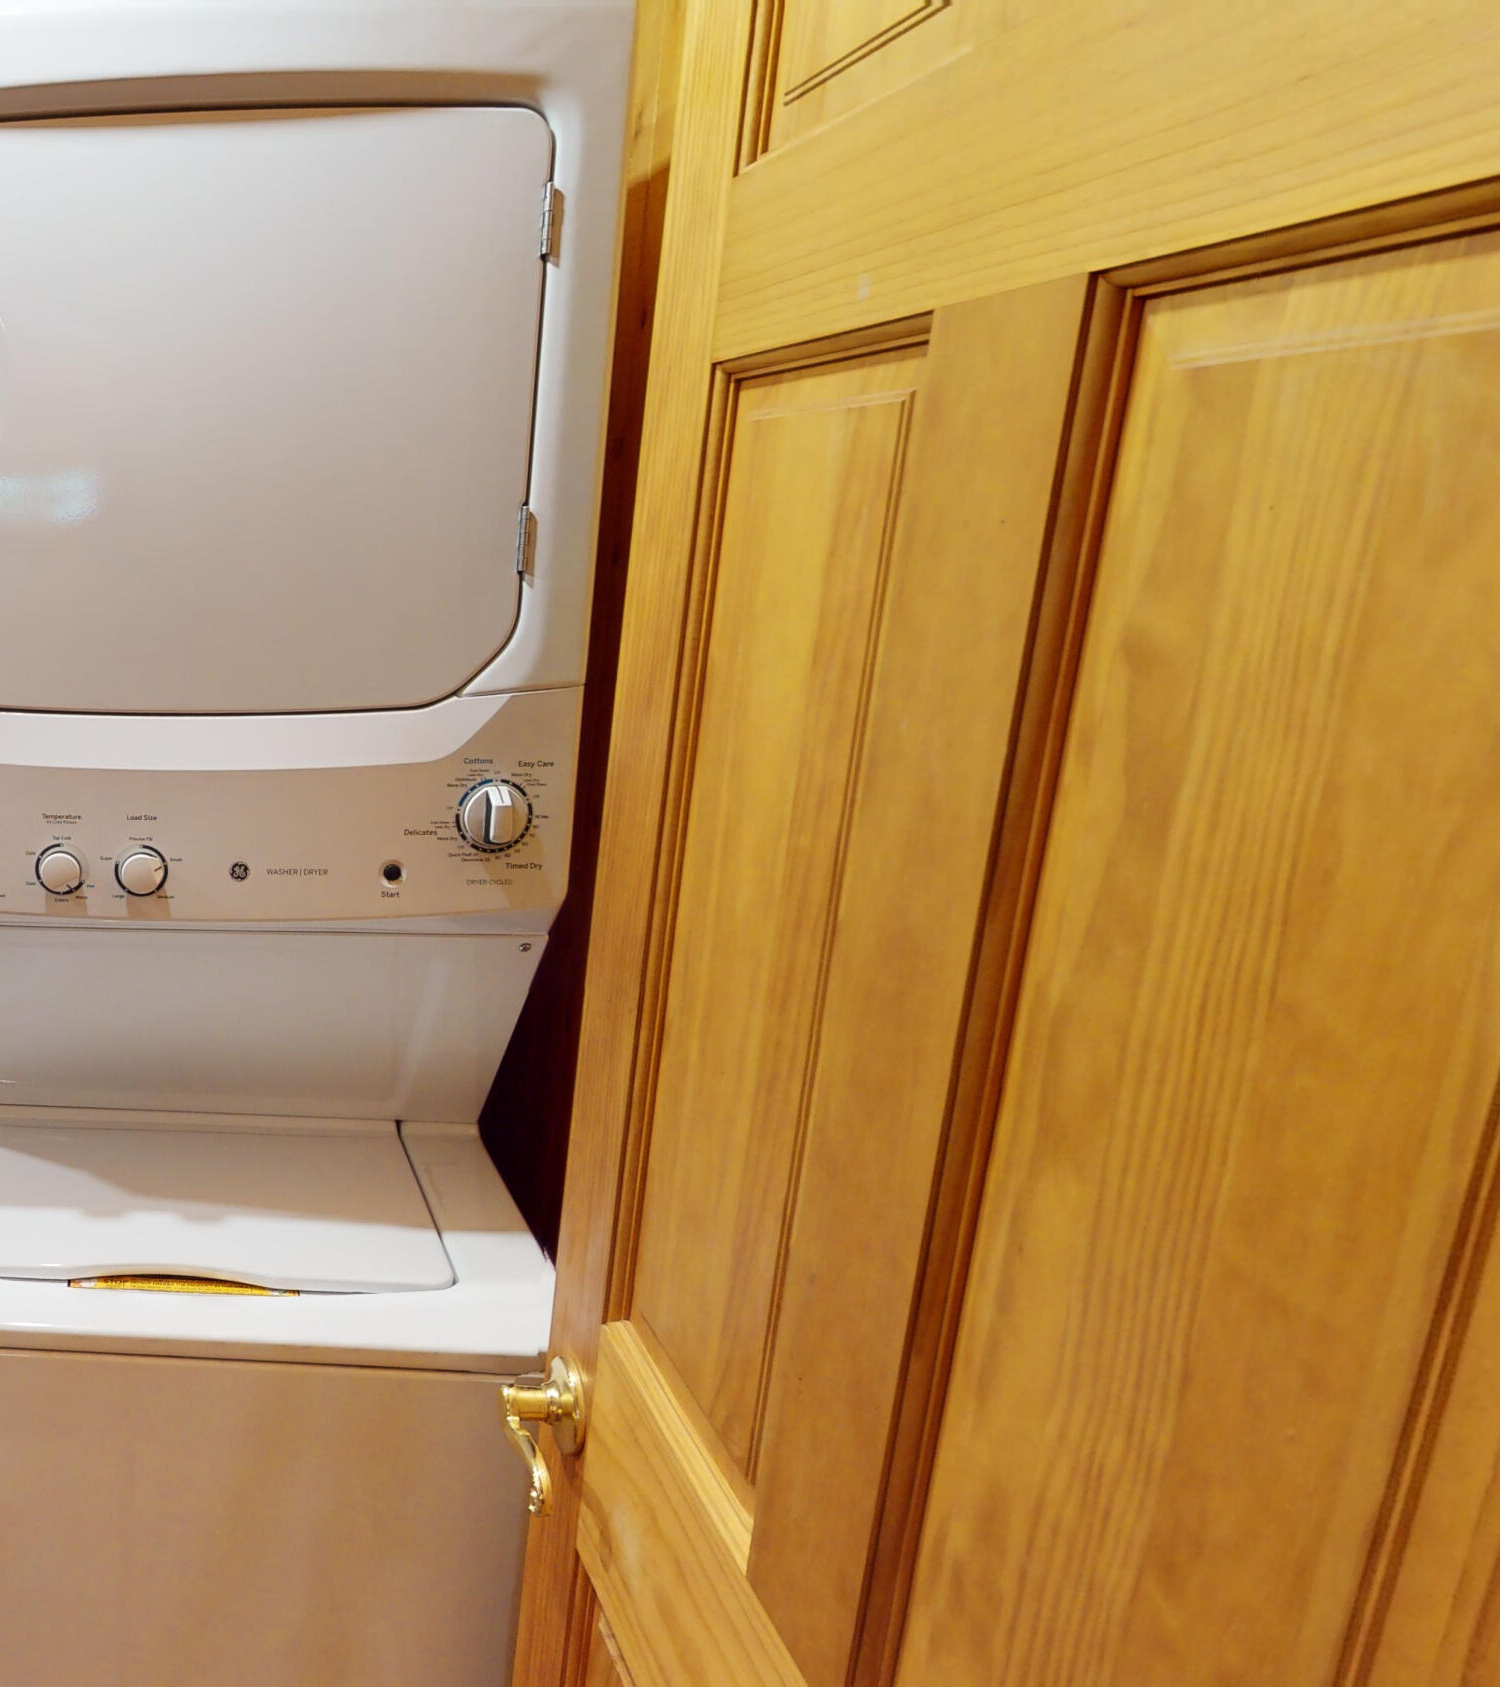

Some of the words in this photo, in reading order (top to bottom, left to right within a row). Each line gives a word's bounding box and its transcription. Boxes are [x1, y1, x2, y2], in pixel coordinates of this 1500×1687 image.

[518, 760, 534, 768] Easy
[42, 812, 82, 820] Temperature
[506, 862, 528, 870] Timed
[266, 868, 298, 876] WASHER
[304, 868, 328, 876] DRYER
